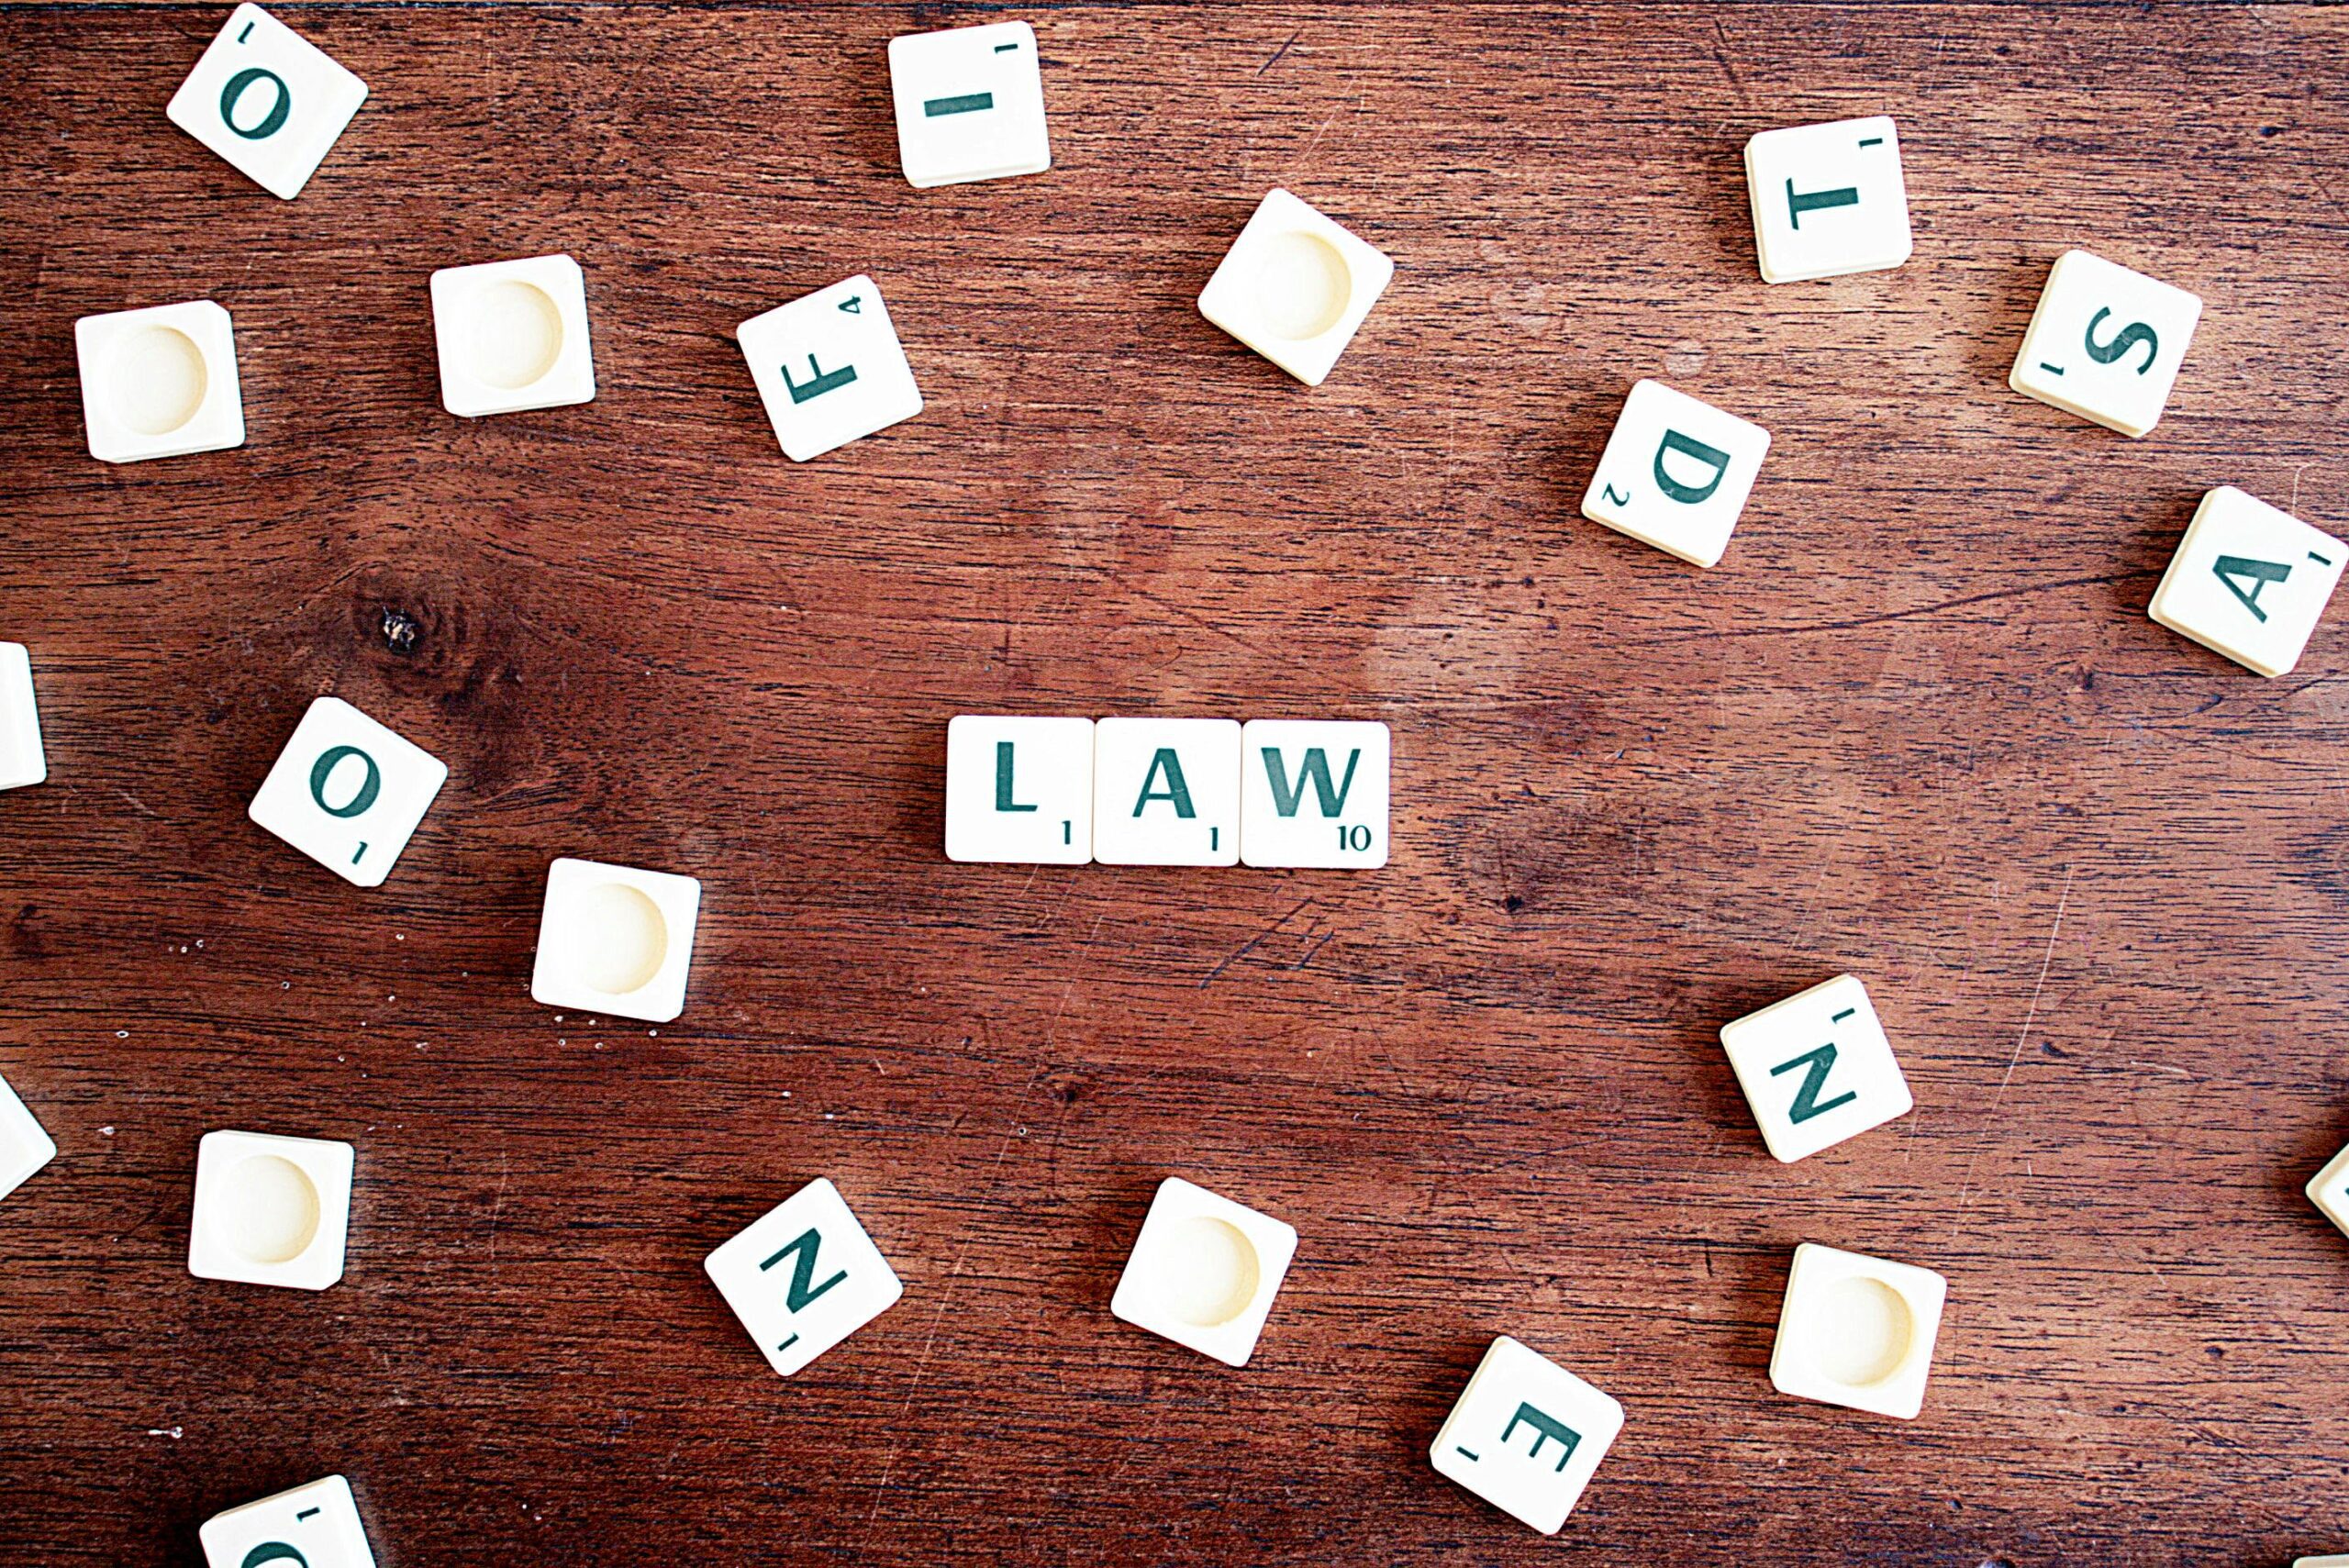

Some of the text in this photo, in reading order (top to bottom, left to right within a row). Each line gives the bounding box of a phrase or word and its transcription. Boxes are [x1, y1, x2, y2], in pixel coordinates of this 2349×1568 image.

[220, 68, 291, 140] O
[923, 92, 995, 118] I
[1786, 177, 1860, 231] T
[837, 295, 862, 315] 4
[2085, 306, 2159, 376] S
[780, 352, 859, 406] F
[1601, 482, 1631, 507] 2
[1653, 428, 1731, 505] D
[2211, 554, 2293, 624] A
[308, 744, 382, 819] O
[996, 741, 1362, 819] LAW
[1339, 825, 1373, 852] 10
[1769, 1041, 1858, 1126] N
[758, 1227, 849, 1315] N
[1500, 1401, 1583, 1473] E
